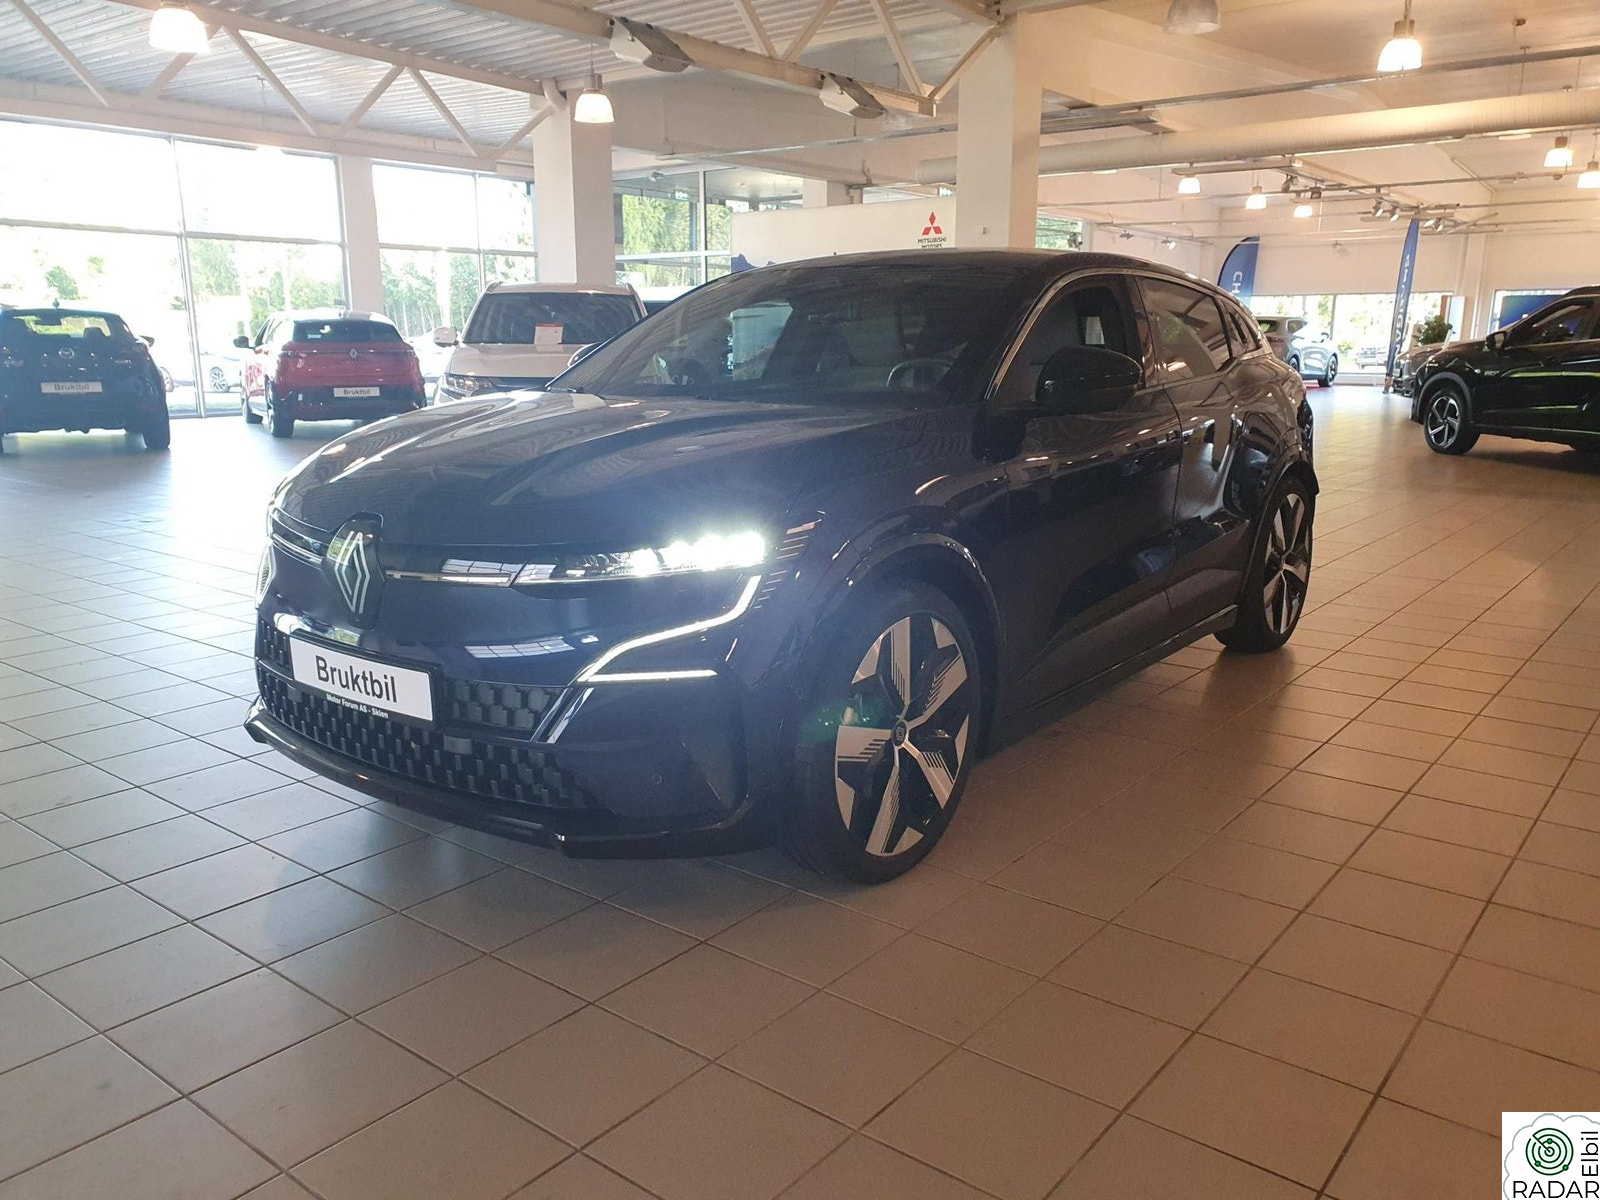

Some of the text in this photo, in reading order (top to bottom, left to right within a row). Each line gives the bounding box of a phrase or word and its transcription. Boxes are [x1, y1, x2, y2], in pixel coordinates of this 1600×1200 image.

[54, 383, 90, 391] Bruktbil
[315, 655, 398, 703] Bruktbil
[326, 693, 341, 704] Motor
[342, 698, 359, 710] Forum
[360, 704, 368, 713] AS
[372, 707, 389, 719] Skien
